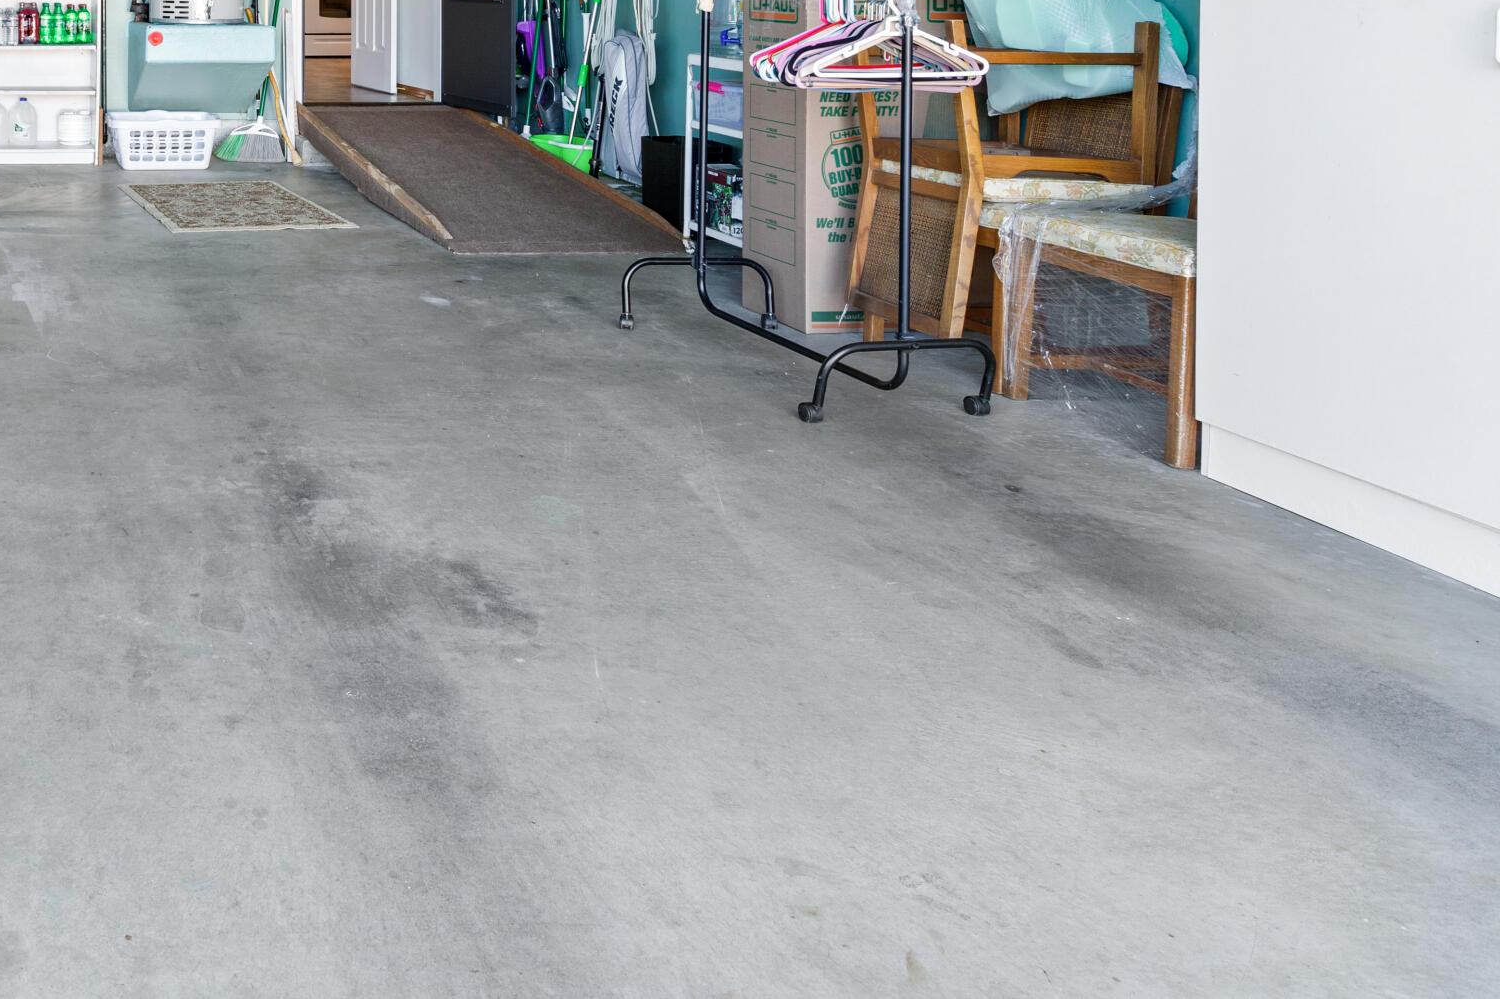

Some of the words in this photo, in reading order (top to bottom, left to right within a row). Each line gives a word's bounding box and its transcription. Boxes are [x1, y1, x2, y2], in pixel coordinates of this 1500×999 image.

[819, 91, 851, 103] NEED
[820, 106, 849, 117] TAKE
[816, 217, 845, 229] We'll
[827, 231, 847, 243] the
